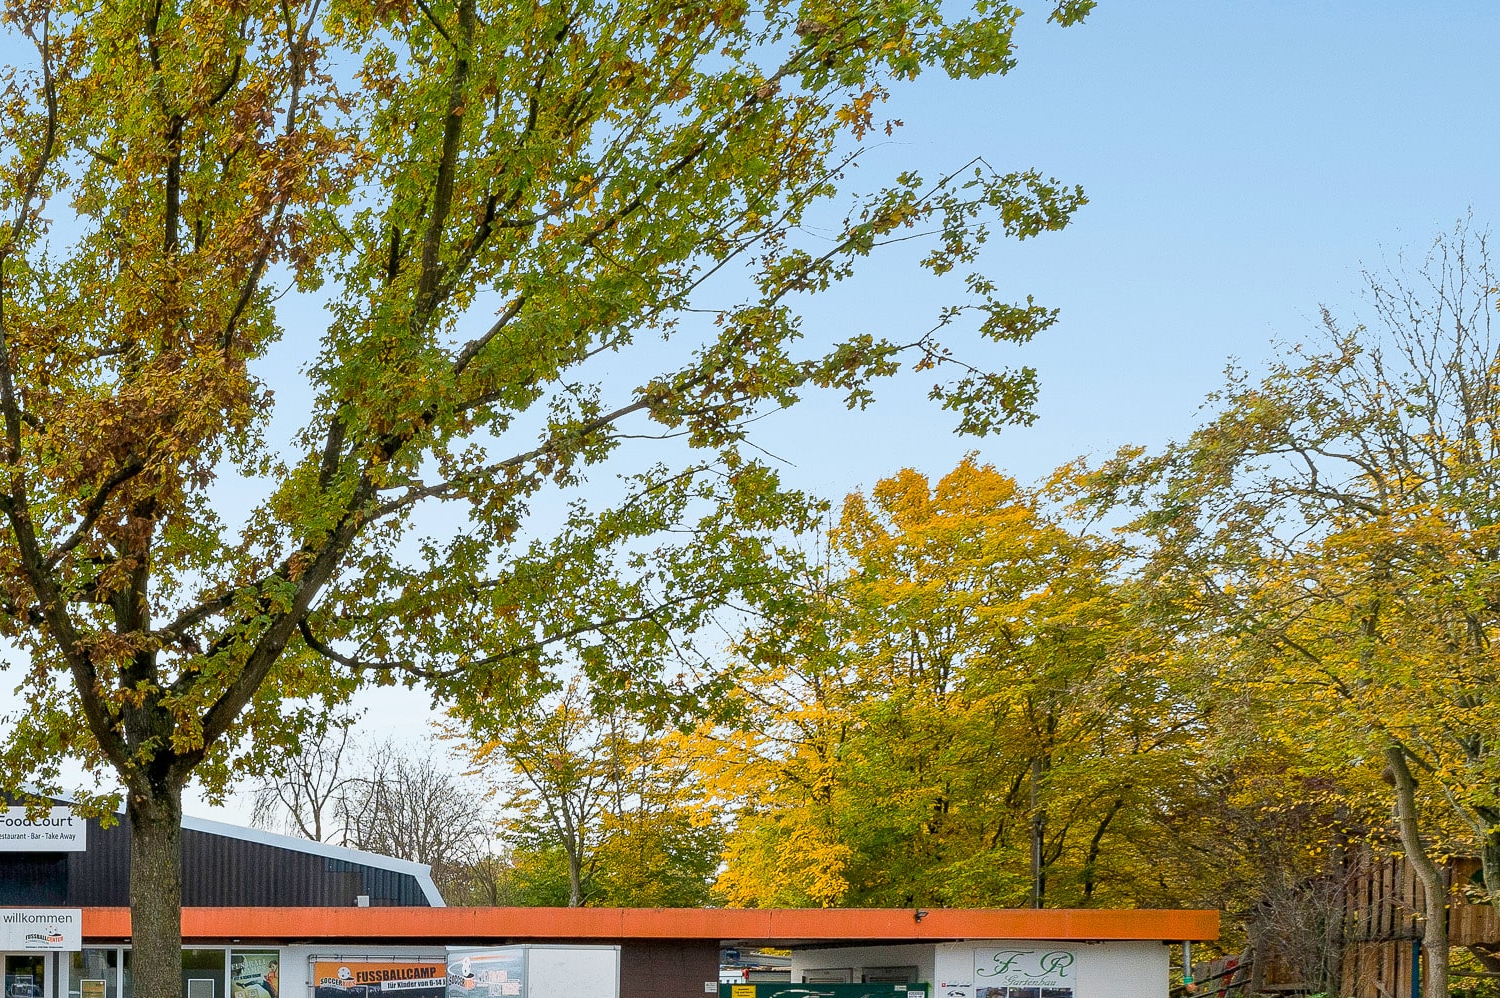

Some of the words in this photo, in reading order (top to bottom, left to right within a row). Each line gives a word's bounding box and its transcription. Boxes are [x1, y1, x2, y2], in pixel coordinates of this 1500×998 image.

[30, 832, 41, 840] Bar
[45, 832, 59, 840] Take
[59, 832, 76, 841] Away
[3, 912, 73, 923] willkommen
[356, 967, 437, 983] FUSSBALLCAMP
[1003, 975, 1058, 986] Gartenbau
[397, 980, 417, 989] Kinder
[429, 979, 442, 987] 6-14
